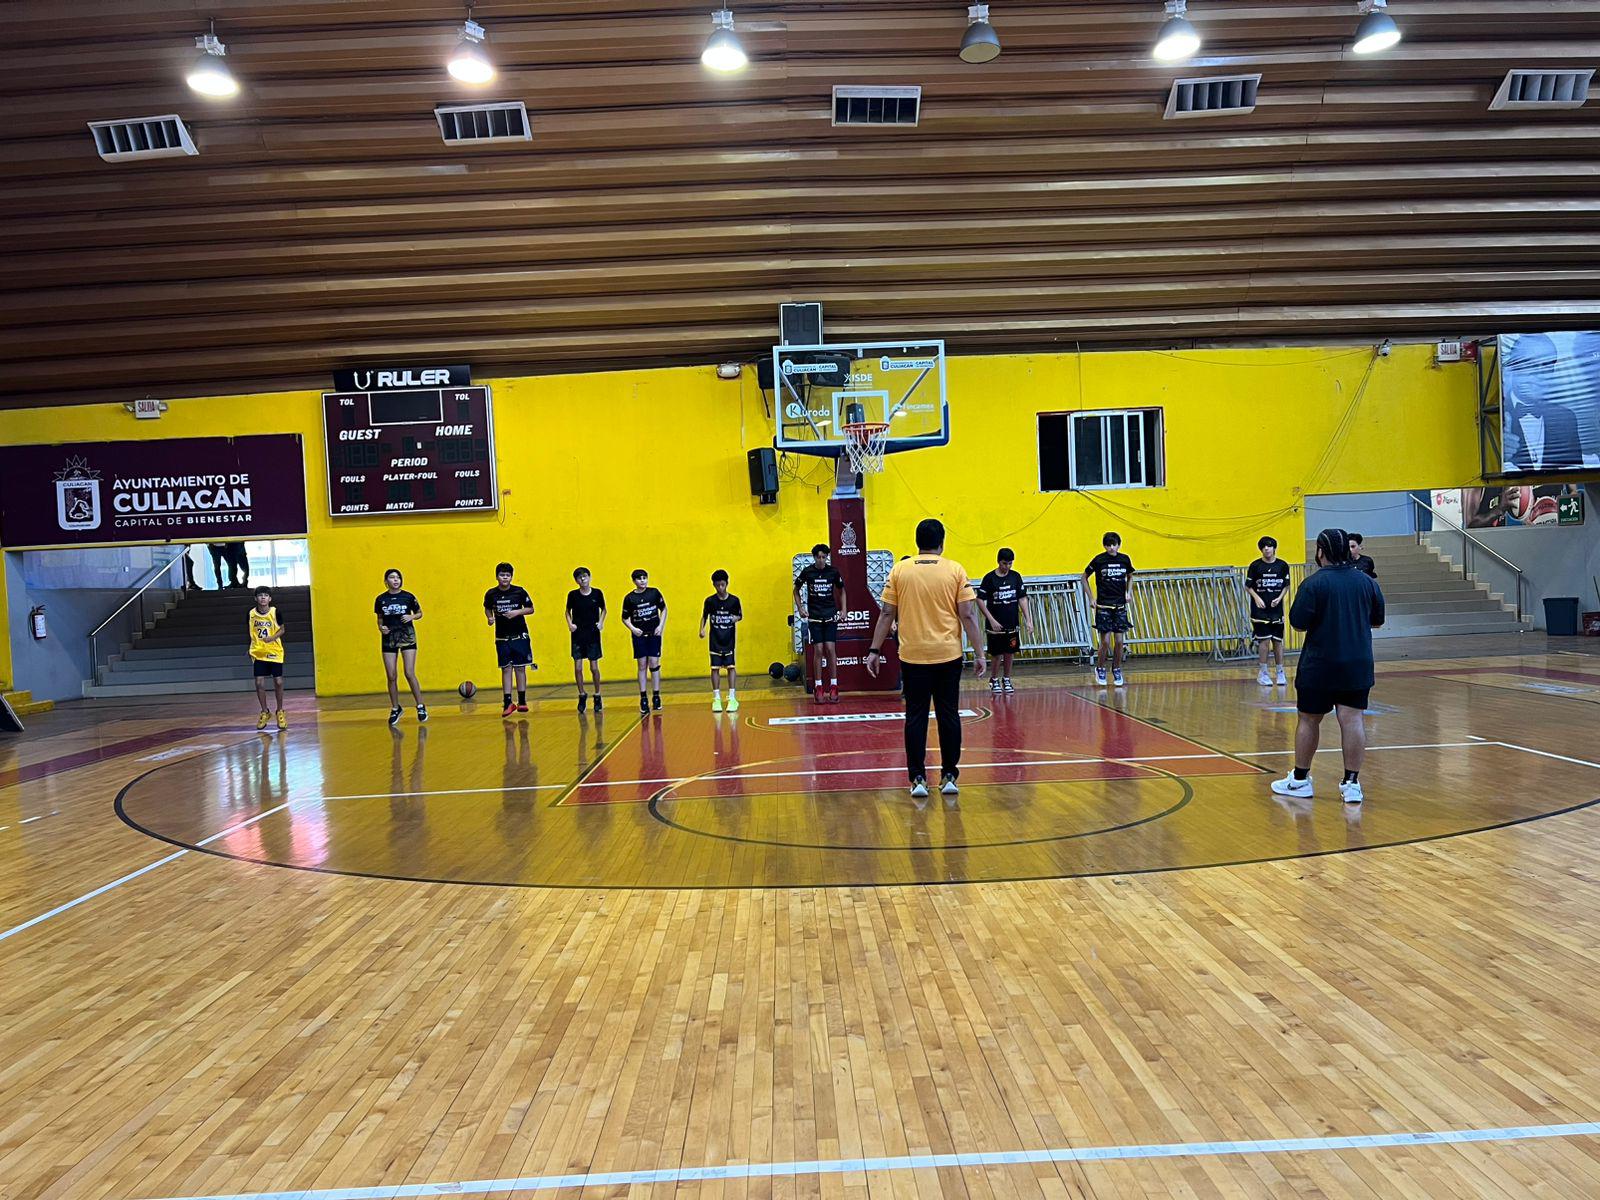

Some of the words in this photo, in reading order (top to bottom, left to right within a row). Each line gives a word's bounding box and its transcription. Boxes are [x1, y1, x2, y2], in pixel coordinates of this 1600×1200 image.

[377, 369, 450, 387] RULER
[455, 393, 470, 401] TOL
[339, 429, 381, 441] GUEST
[435, 424, 473, 437] HOME
[390, 457, 428, 467] PERIOD
[340, 475, 365, 483] FOULS
[383, 472, 438, 481] PLAYER-FOUL
[455, 470, 480, 478] FOULS
[113, 475, 226, 490] AYUNTAMIENTO
[230, 474, 249, 485] DE
[113, 487, 251, 512] CULIACÁN
[455, 498, 484, 507] POINTS
[340, 504, 369, 512] POINTS
[386, 502, 414, 510] MATCH
[114, 517, 162, 528] CAPITAL
[167, 517, 182, 525] DE
[187, 514, 252, 525] BIENESTAR
[844, 611, 870, 621] SDE
[257, 628, 268, 638] 24
